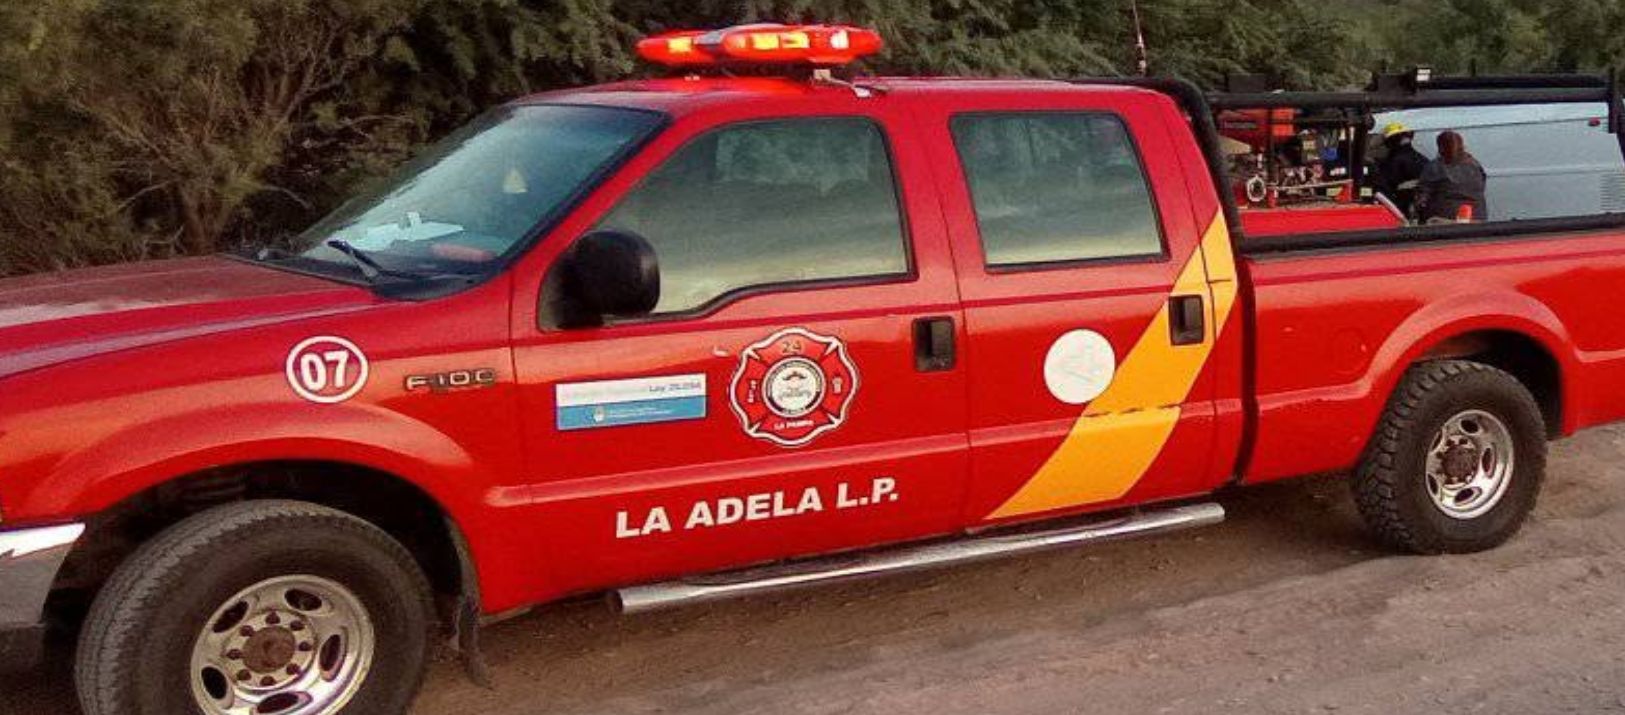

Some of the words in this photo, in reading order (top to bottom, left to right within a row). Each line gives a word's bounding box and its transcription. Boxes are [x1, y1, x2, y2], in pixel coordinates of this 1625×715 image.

[299, 349, 350, 391] 07
[615, 505, 672, 538] LA
[683, 486, 823, 530] ADELA
[835, 477, 899, 509] L.P.
